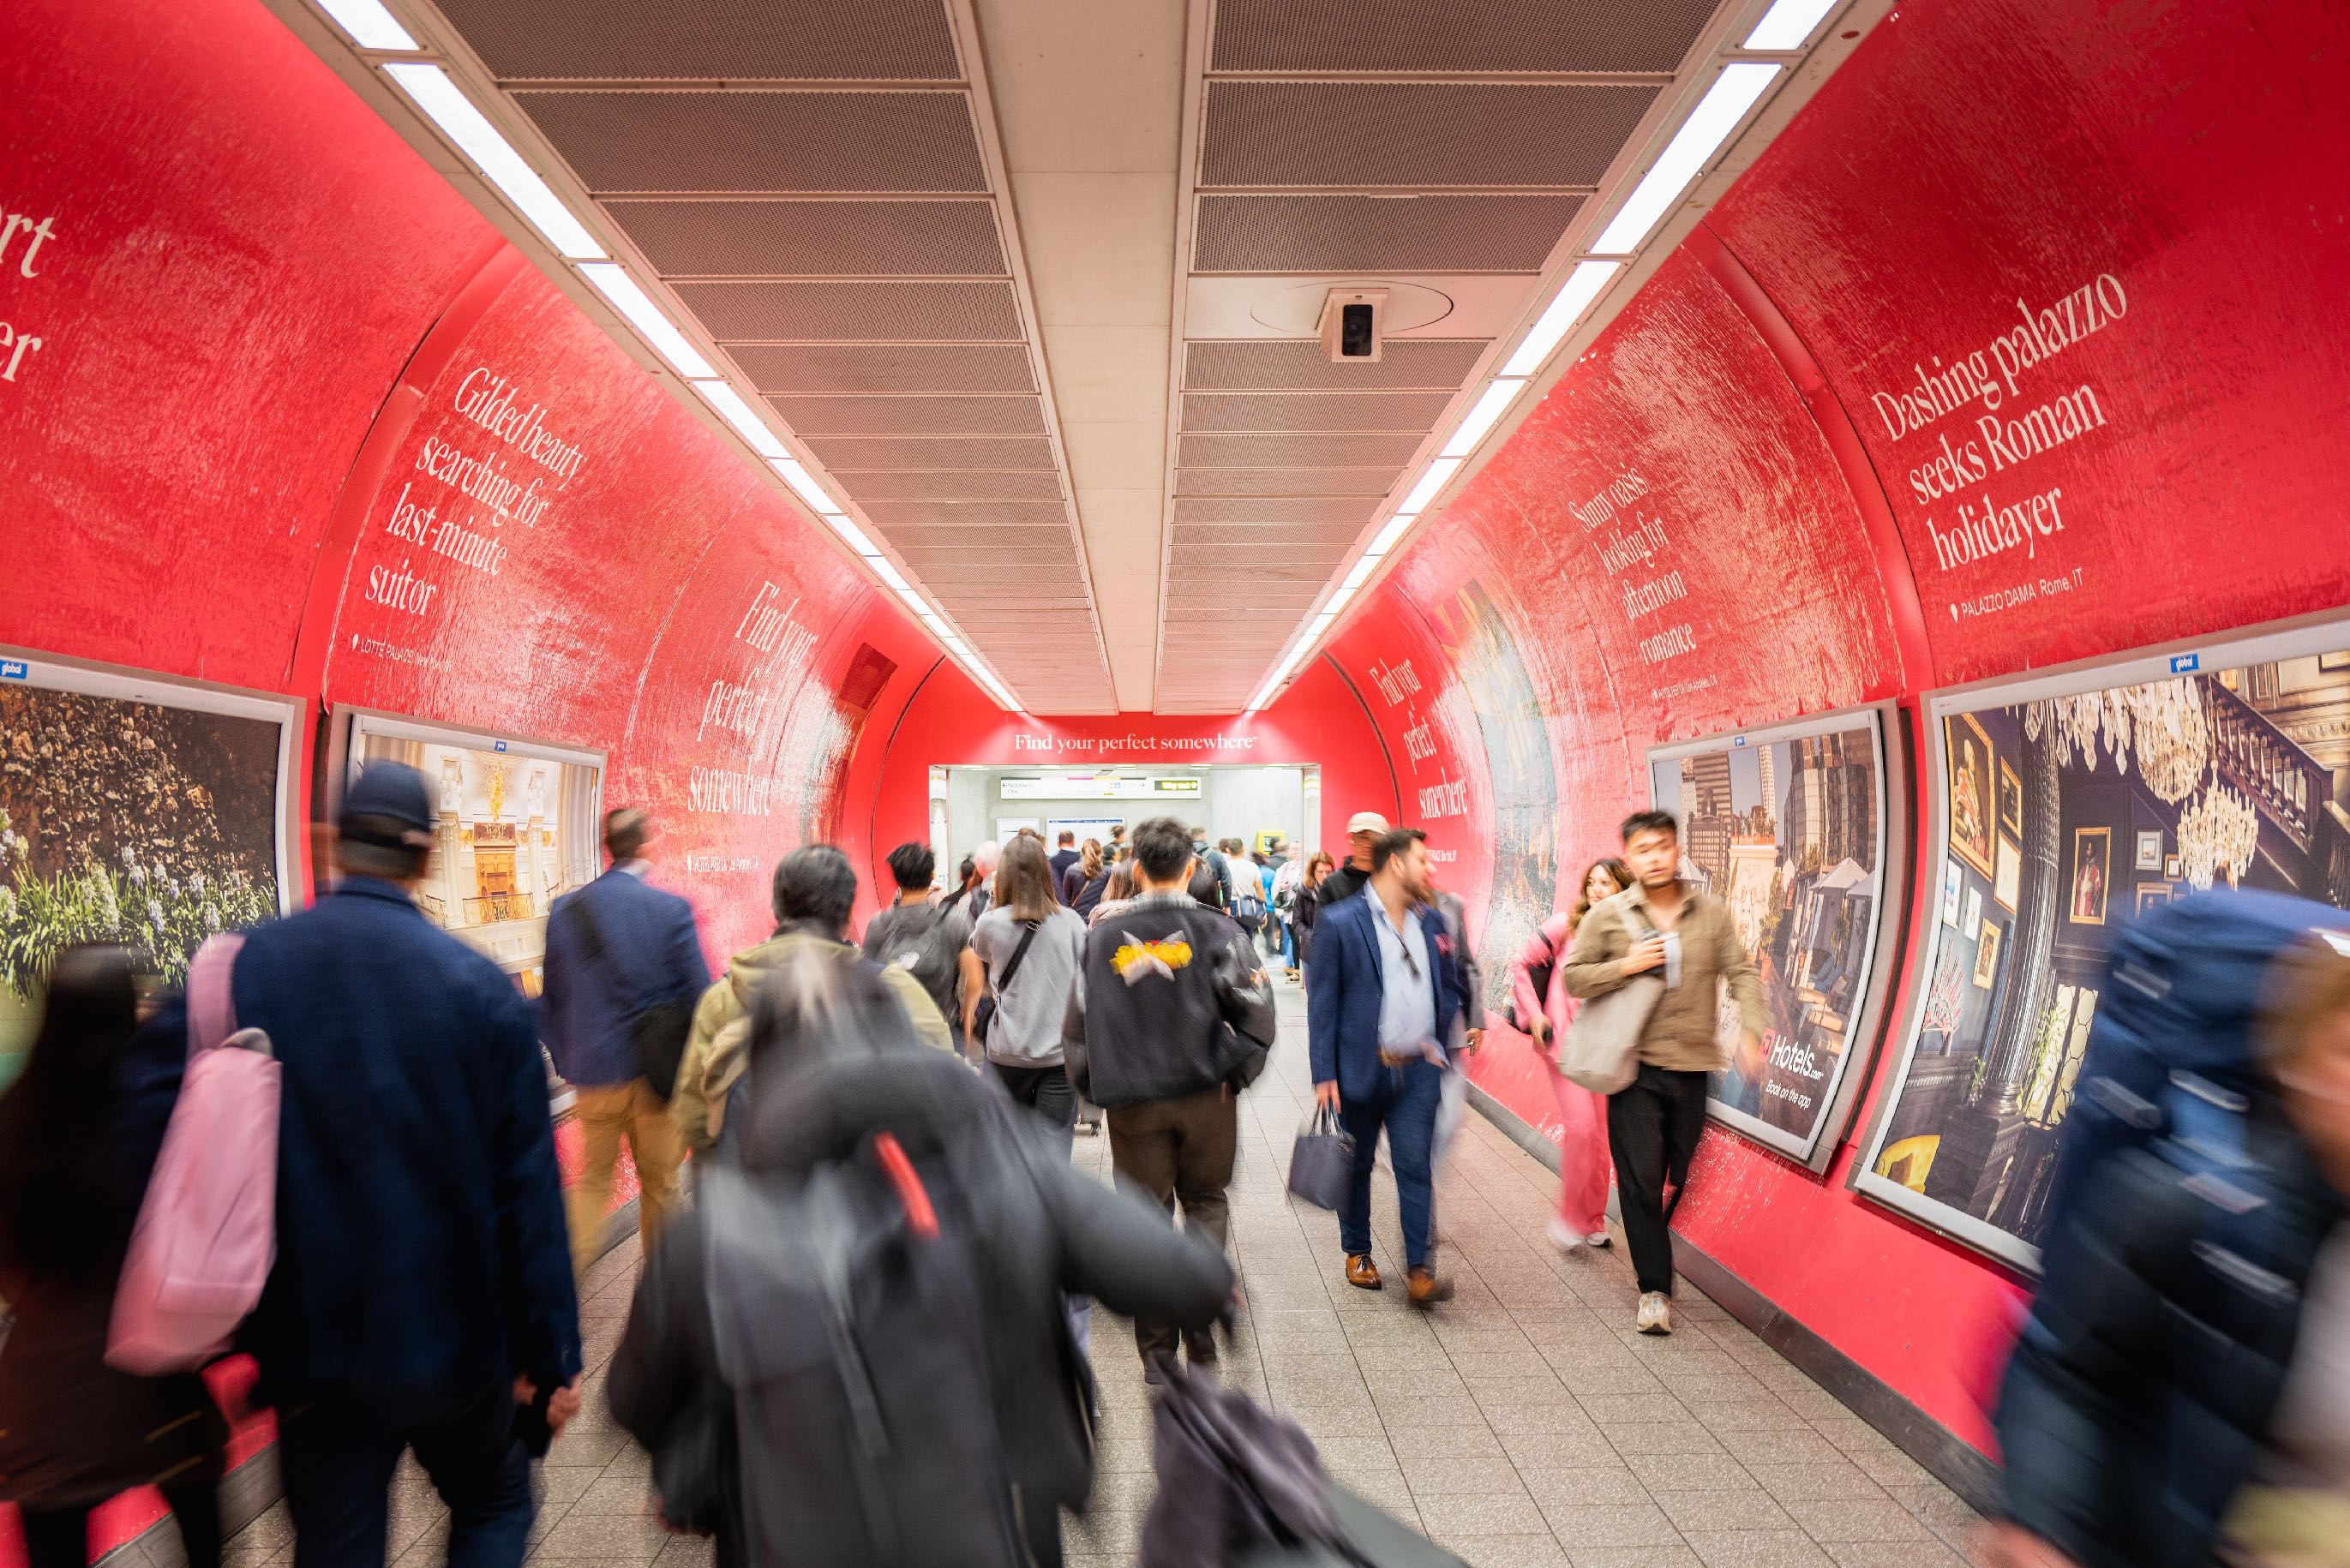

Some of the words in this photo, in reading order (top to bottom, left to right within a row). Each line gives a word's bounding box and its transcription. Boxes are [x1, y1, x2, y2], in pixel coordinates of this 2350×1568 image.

[0, 203, 56, 278] rt
[1871, 350, 2001, 441] Dashing
[1990, 273, 2127, 397] palazzo
[454, 367, 540, 445] Gilded
[519, 410, 587, 492] beauty
[1909, 434, 1987, 506] seeks
[1976, 384, 2106, 471] Roman
[416, 437, 521, 527] searching
[513, 478, 549, 528] for
[1569, 490, 1621, 532] Sunny
[1610, 462, 1648, 508] oasis
[386, 482, 507, 576] last-minute
[1594, 529, 1654, 576] looking
[1637, 512, 1670, 551] for
[1927, 488, 2065, 571] holidayer
[364, 559, 436, 616] suitor
[734, 581, 800, 652] Find
[1622, 570, 1688, 620] afternoon
[1961, 593, 2004, 619] PALAZZO
[2005, 584, 2036, 608] DAMA
[2039, 577, 2072, 596] Rome,
[2072, 567, 2083, 587] IT
[2, 662, 21, 675] global
[360, 639, 386, 657] LOTTE
[386, 644, 414, 664] PALACE
[765, 620, 819, 674] your
[1640, 622, 1696, 665] romance
[2176, 655, 2192, 672] global
[697, 667, 769, 742] perfect
[1370, 657, 1404, 707] Find
[1015, 733, 1052, 750] Find
[1057, 737, 1094, 754] your
[1099, 733, 1157, 754] perfect
[1403, 710, 1436, 775] perfect
[687, 754, 771, 817] somewhere
[1418, 766, 1468, 819] somewhere
[1765, 1079, 1782, 1097] Book
[1780, 1087, 1789, 1099] on
[1789, 1088, 1799, 1104] the
[1798, 1094, 1812, 1110] app
